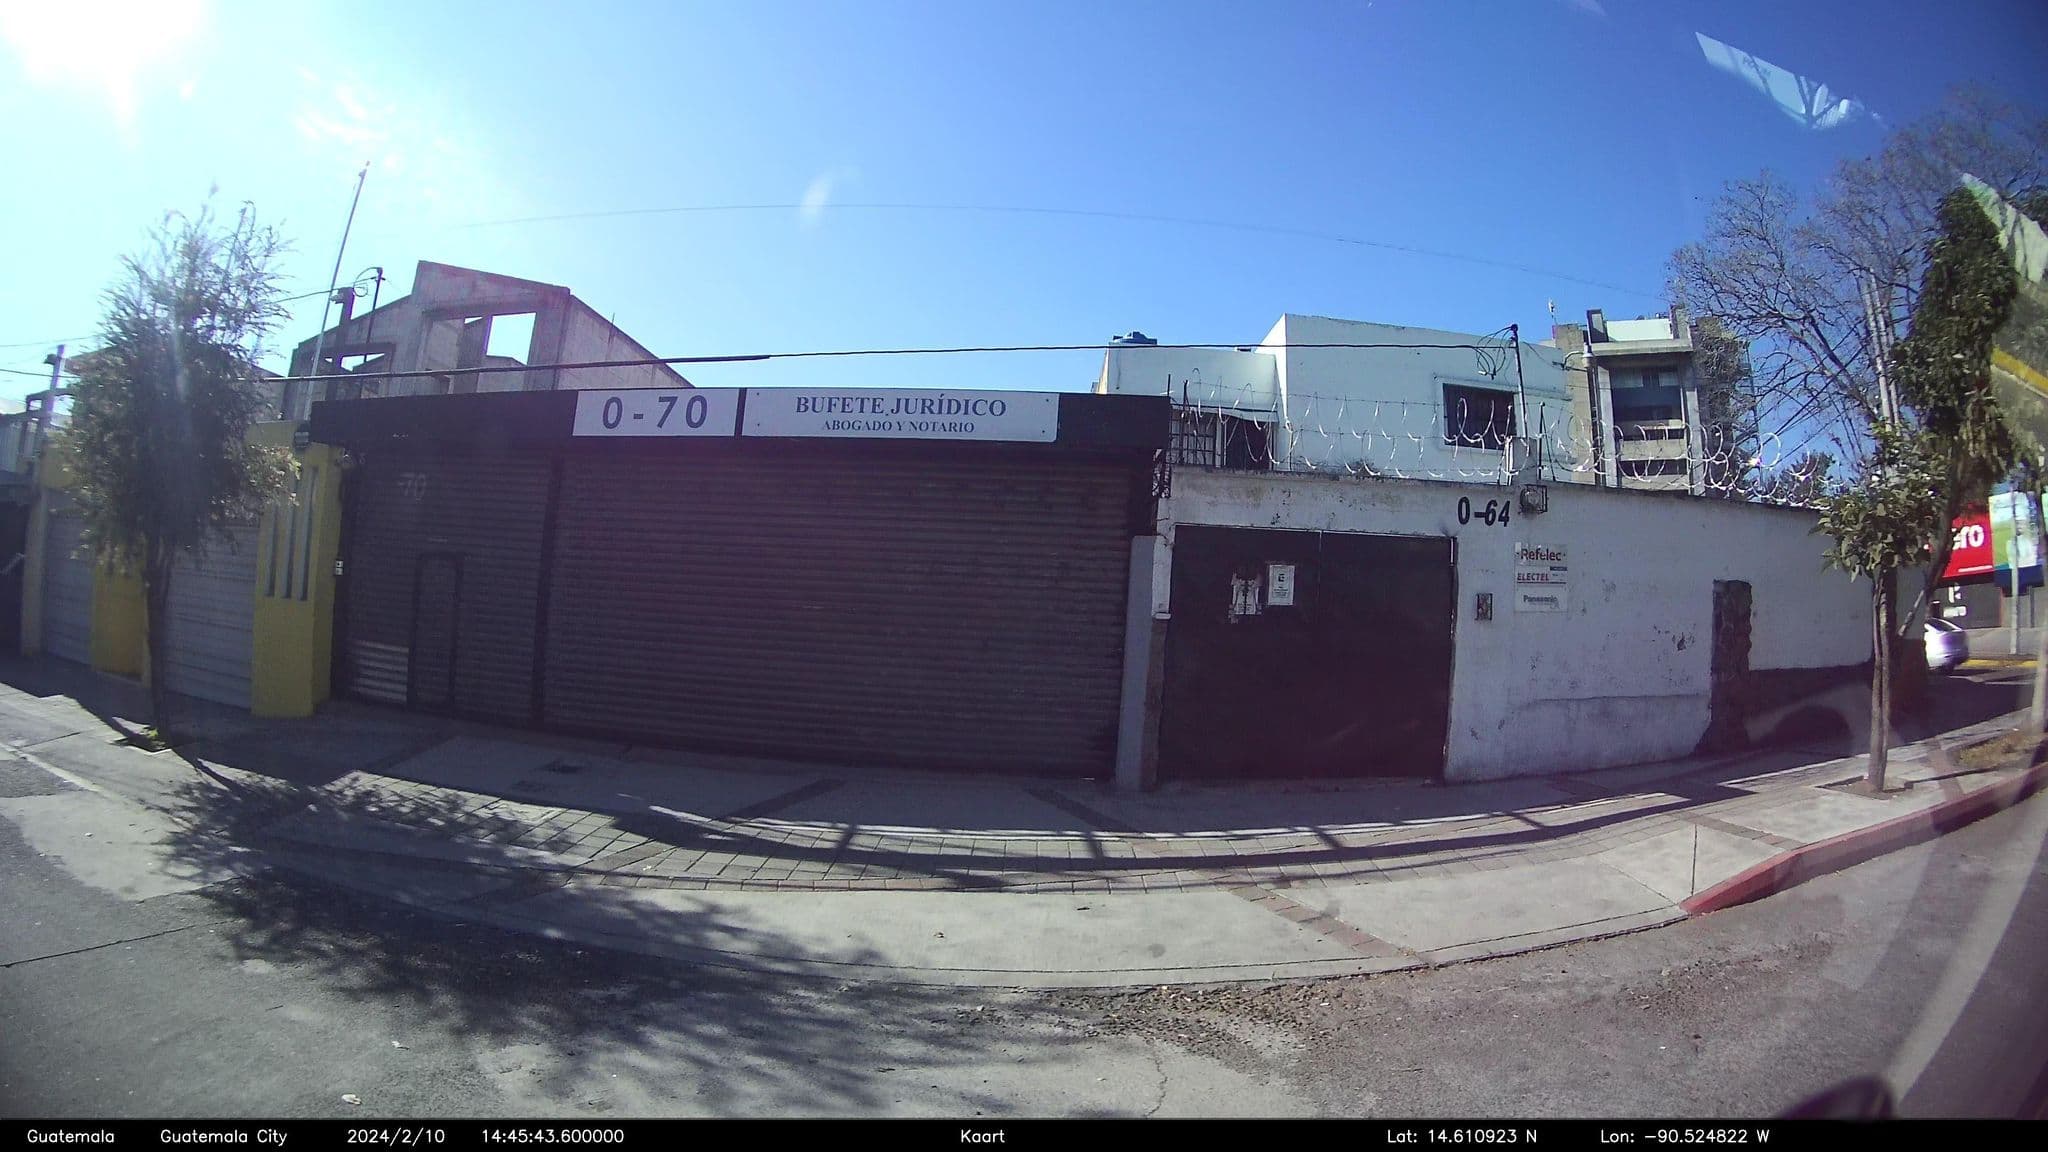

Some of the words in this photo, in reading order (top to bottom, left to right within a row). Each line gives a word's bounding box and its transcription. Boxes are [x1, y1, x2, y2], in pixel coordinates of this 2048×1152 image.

[795, 396, 885, 415] BUFETE
[890, 393, 1007, 417] JURÍDICO
[822, 420, 893, 432] ABOGADO
[896, 421, 904, 432] Y
[909, 421, 975, 433] NOTARIO
[1457, 496, 1511, 527] 0-64
